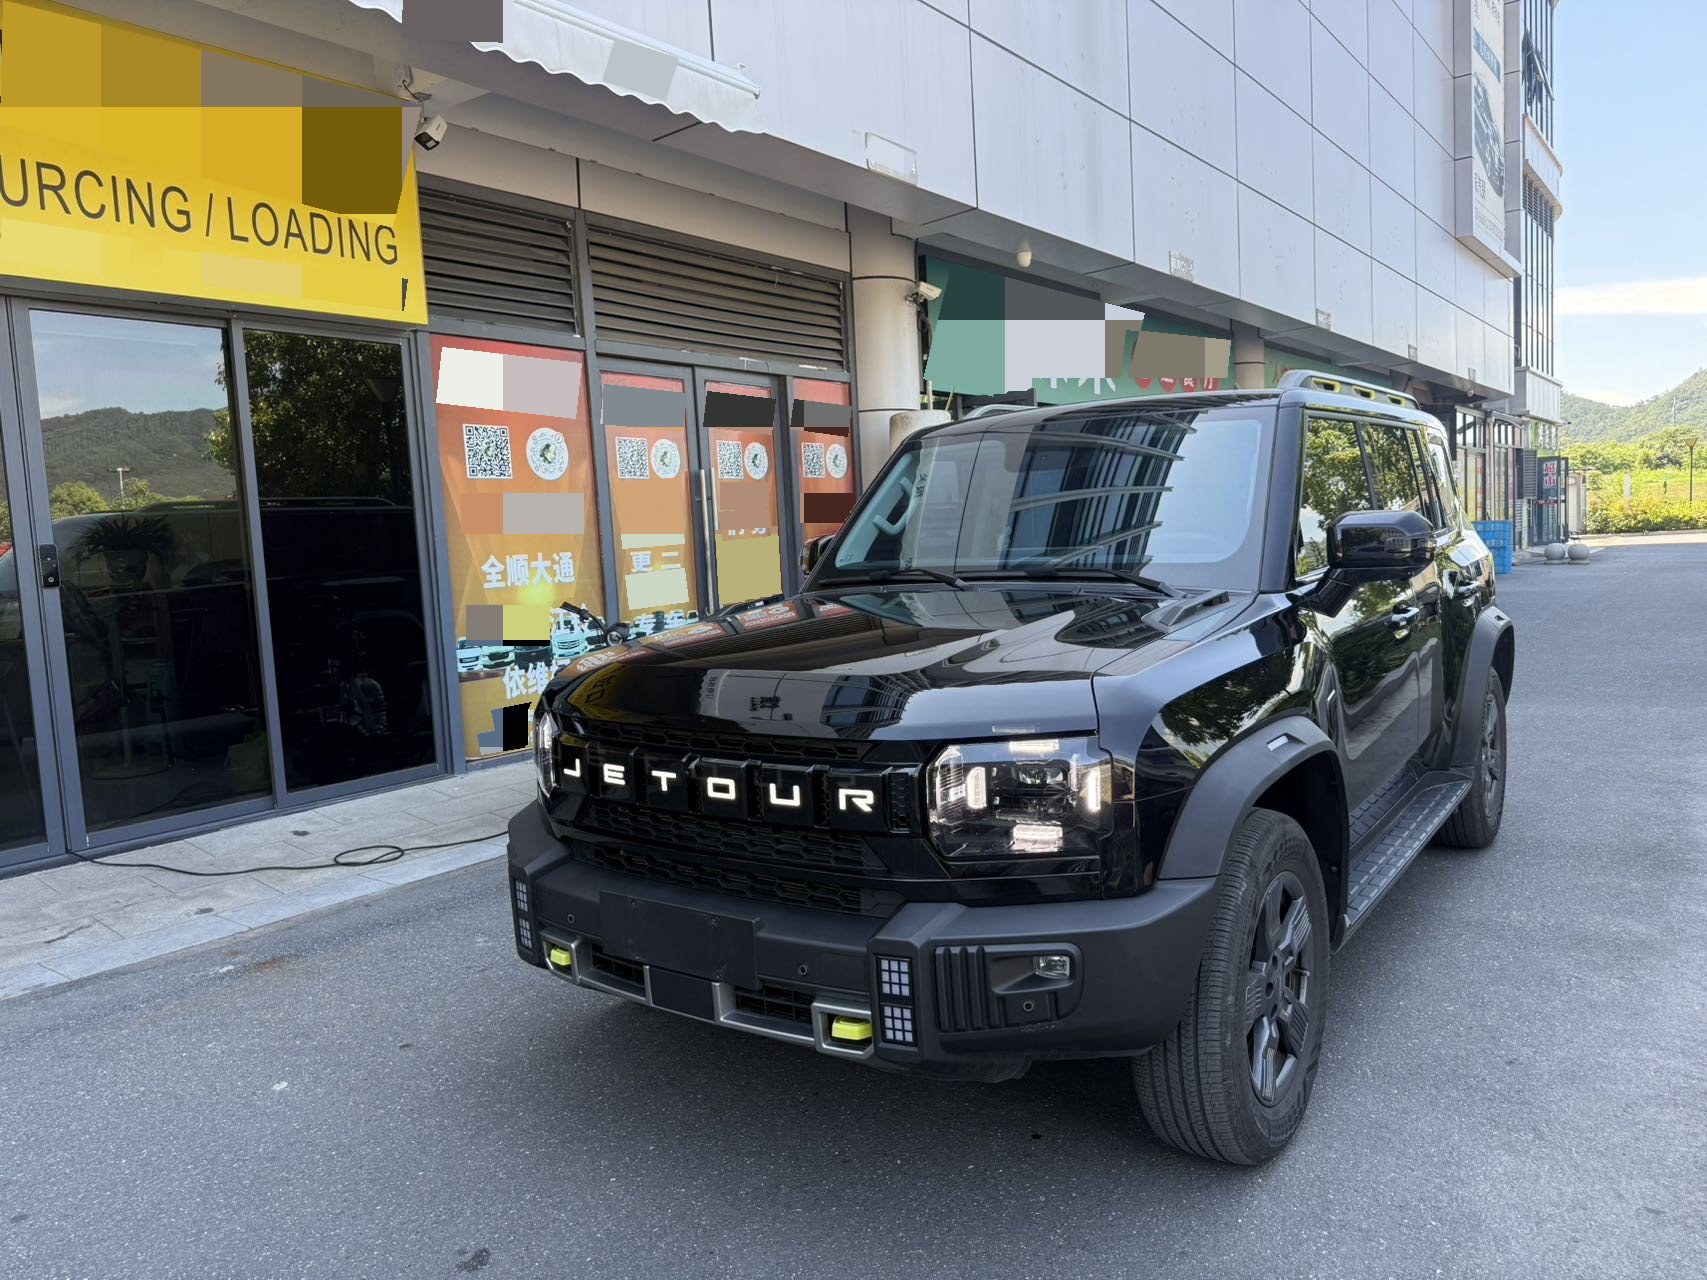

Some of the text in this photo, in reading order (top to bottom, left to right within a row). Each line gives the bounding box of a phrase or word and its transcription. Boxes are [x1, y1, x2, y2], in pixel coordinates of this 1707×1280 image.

[0, 153, 192, 233] URCING
[227, 196, 398, 265] LOADING
[481, 551, 575, 589] 全顺大通
[563, 758, 875, 813] JETOUR
